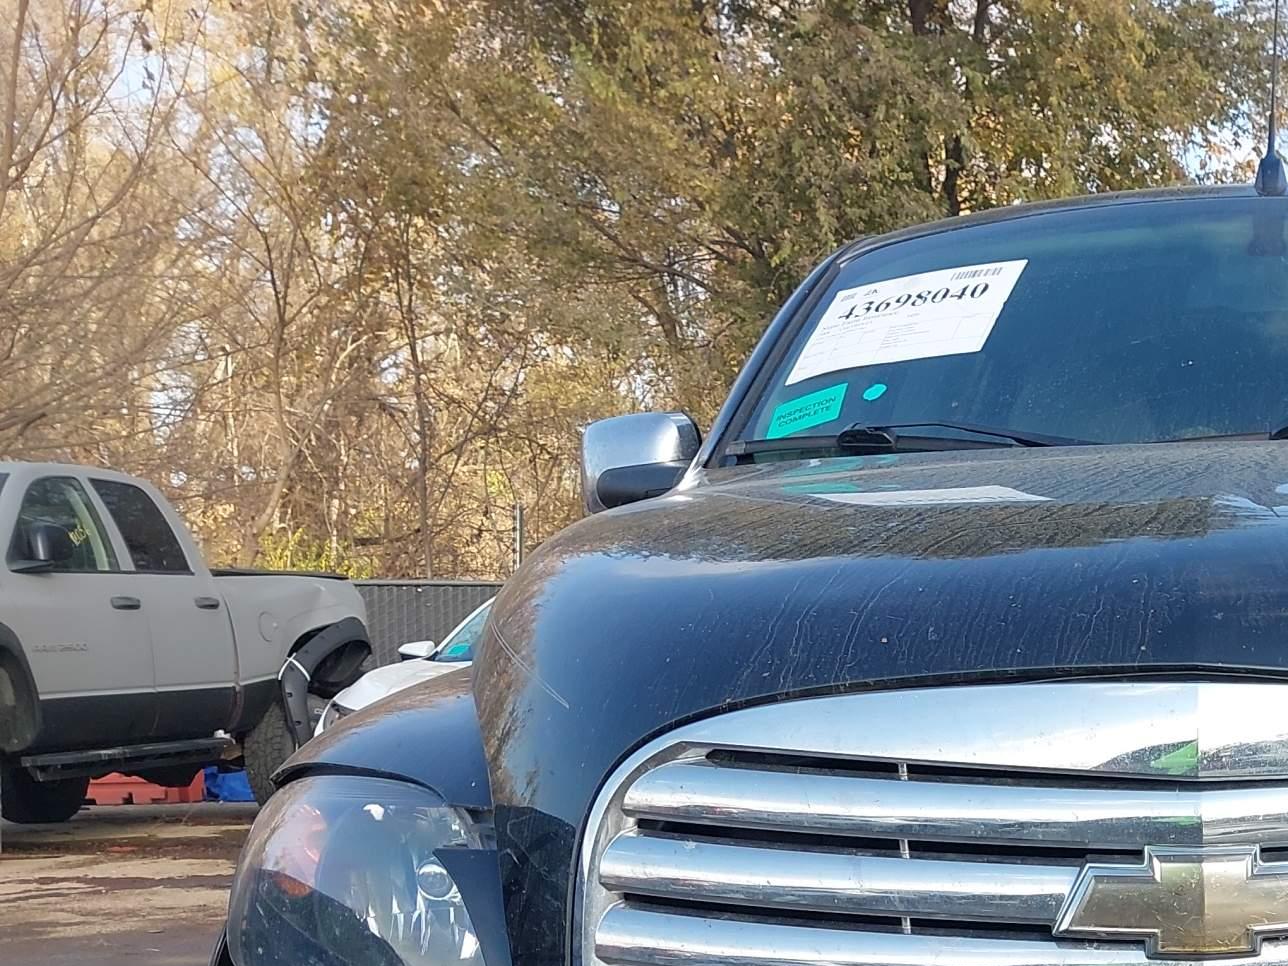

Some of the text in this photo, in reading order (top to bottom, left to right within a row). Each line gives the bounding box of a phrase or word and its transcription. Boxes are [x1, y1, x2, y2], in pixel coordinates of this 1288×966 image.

[838, 282, 990, 320] 43698040
[776, 396, 837, 421] INSPECTION
[778, 405, 833, 427] COMPLETE
